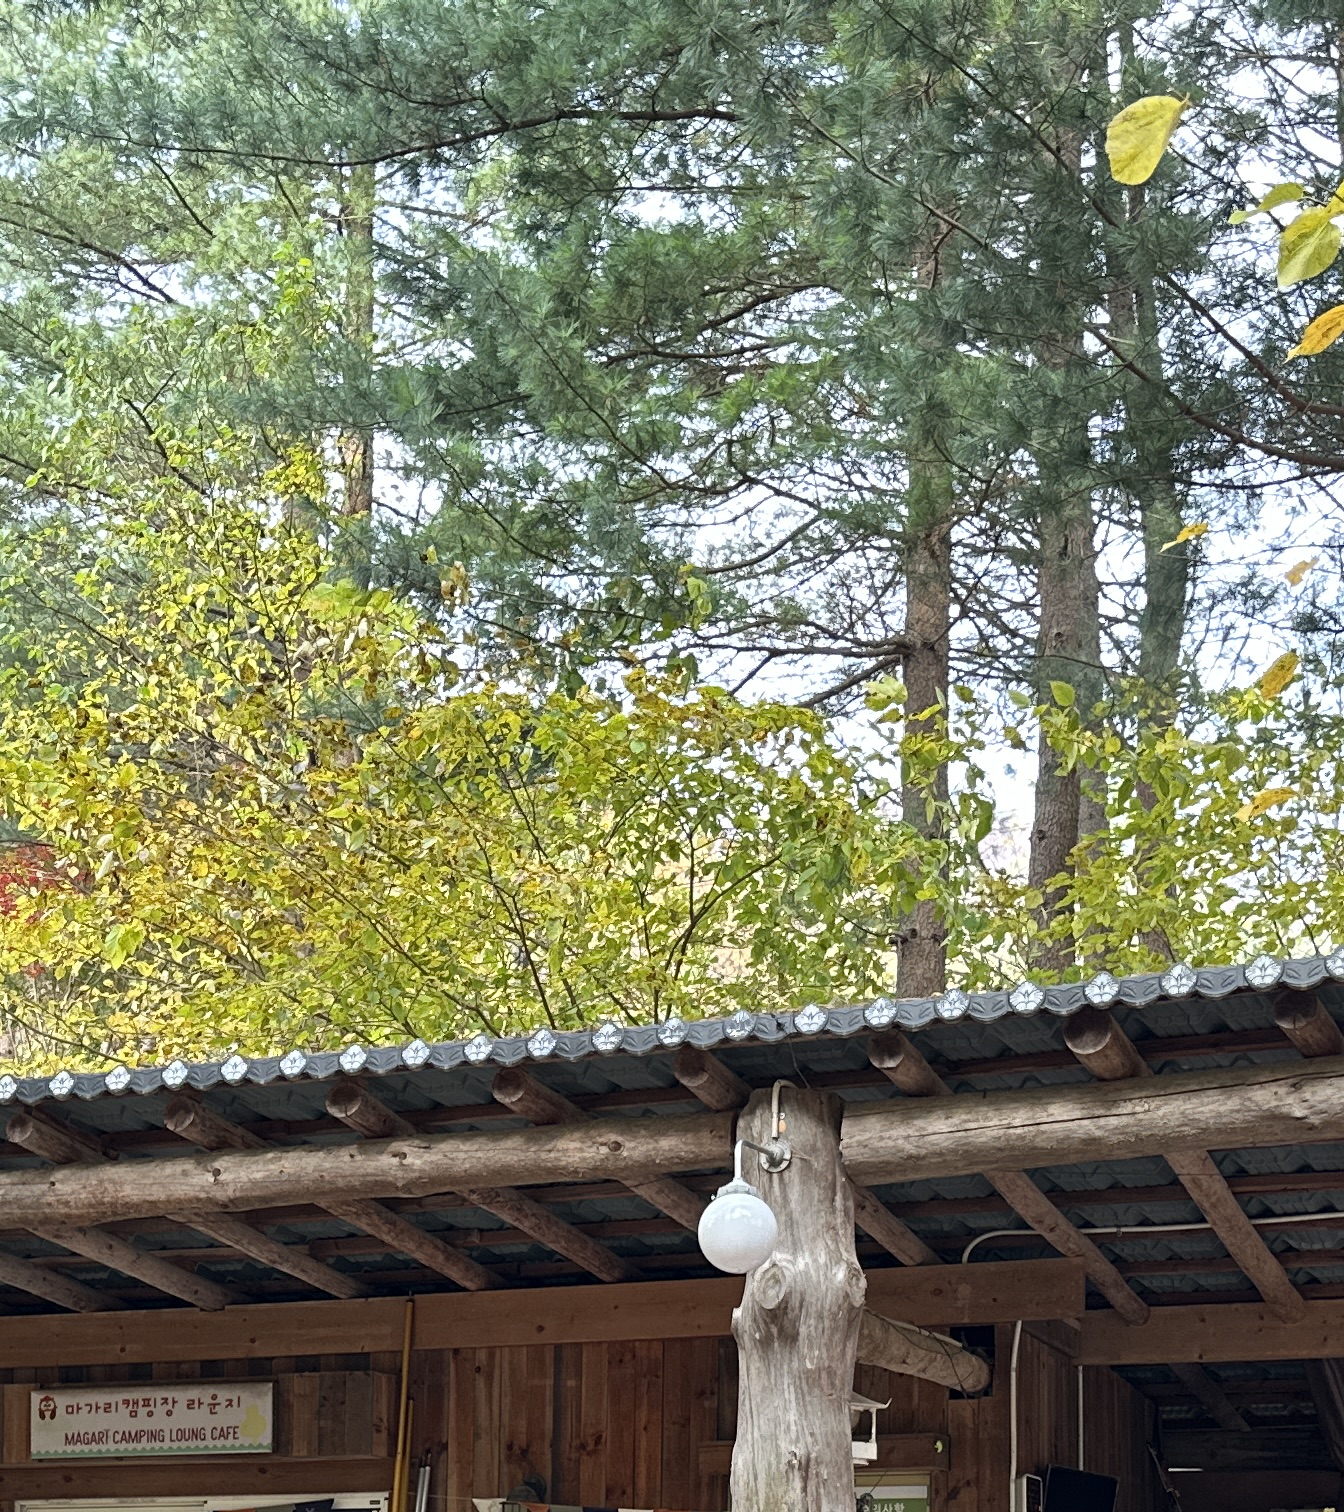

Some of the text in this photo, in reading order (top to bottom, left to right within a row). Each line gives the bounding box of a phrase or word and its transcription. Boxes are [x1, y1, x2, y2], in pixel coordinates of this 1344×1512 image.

[185, 1393, 242, 1415] 라운지
[64, 1425, 240, 1447] MAGARI CAMPING LOUNG CAFE
